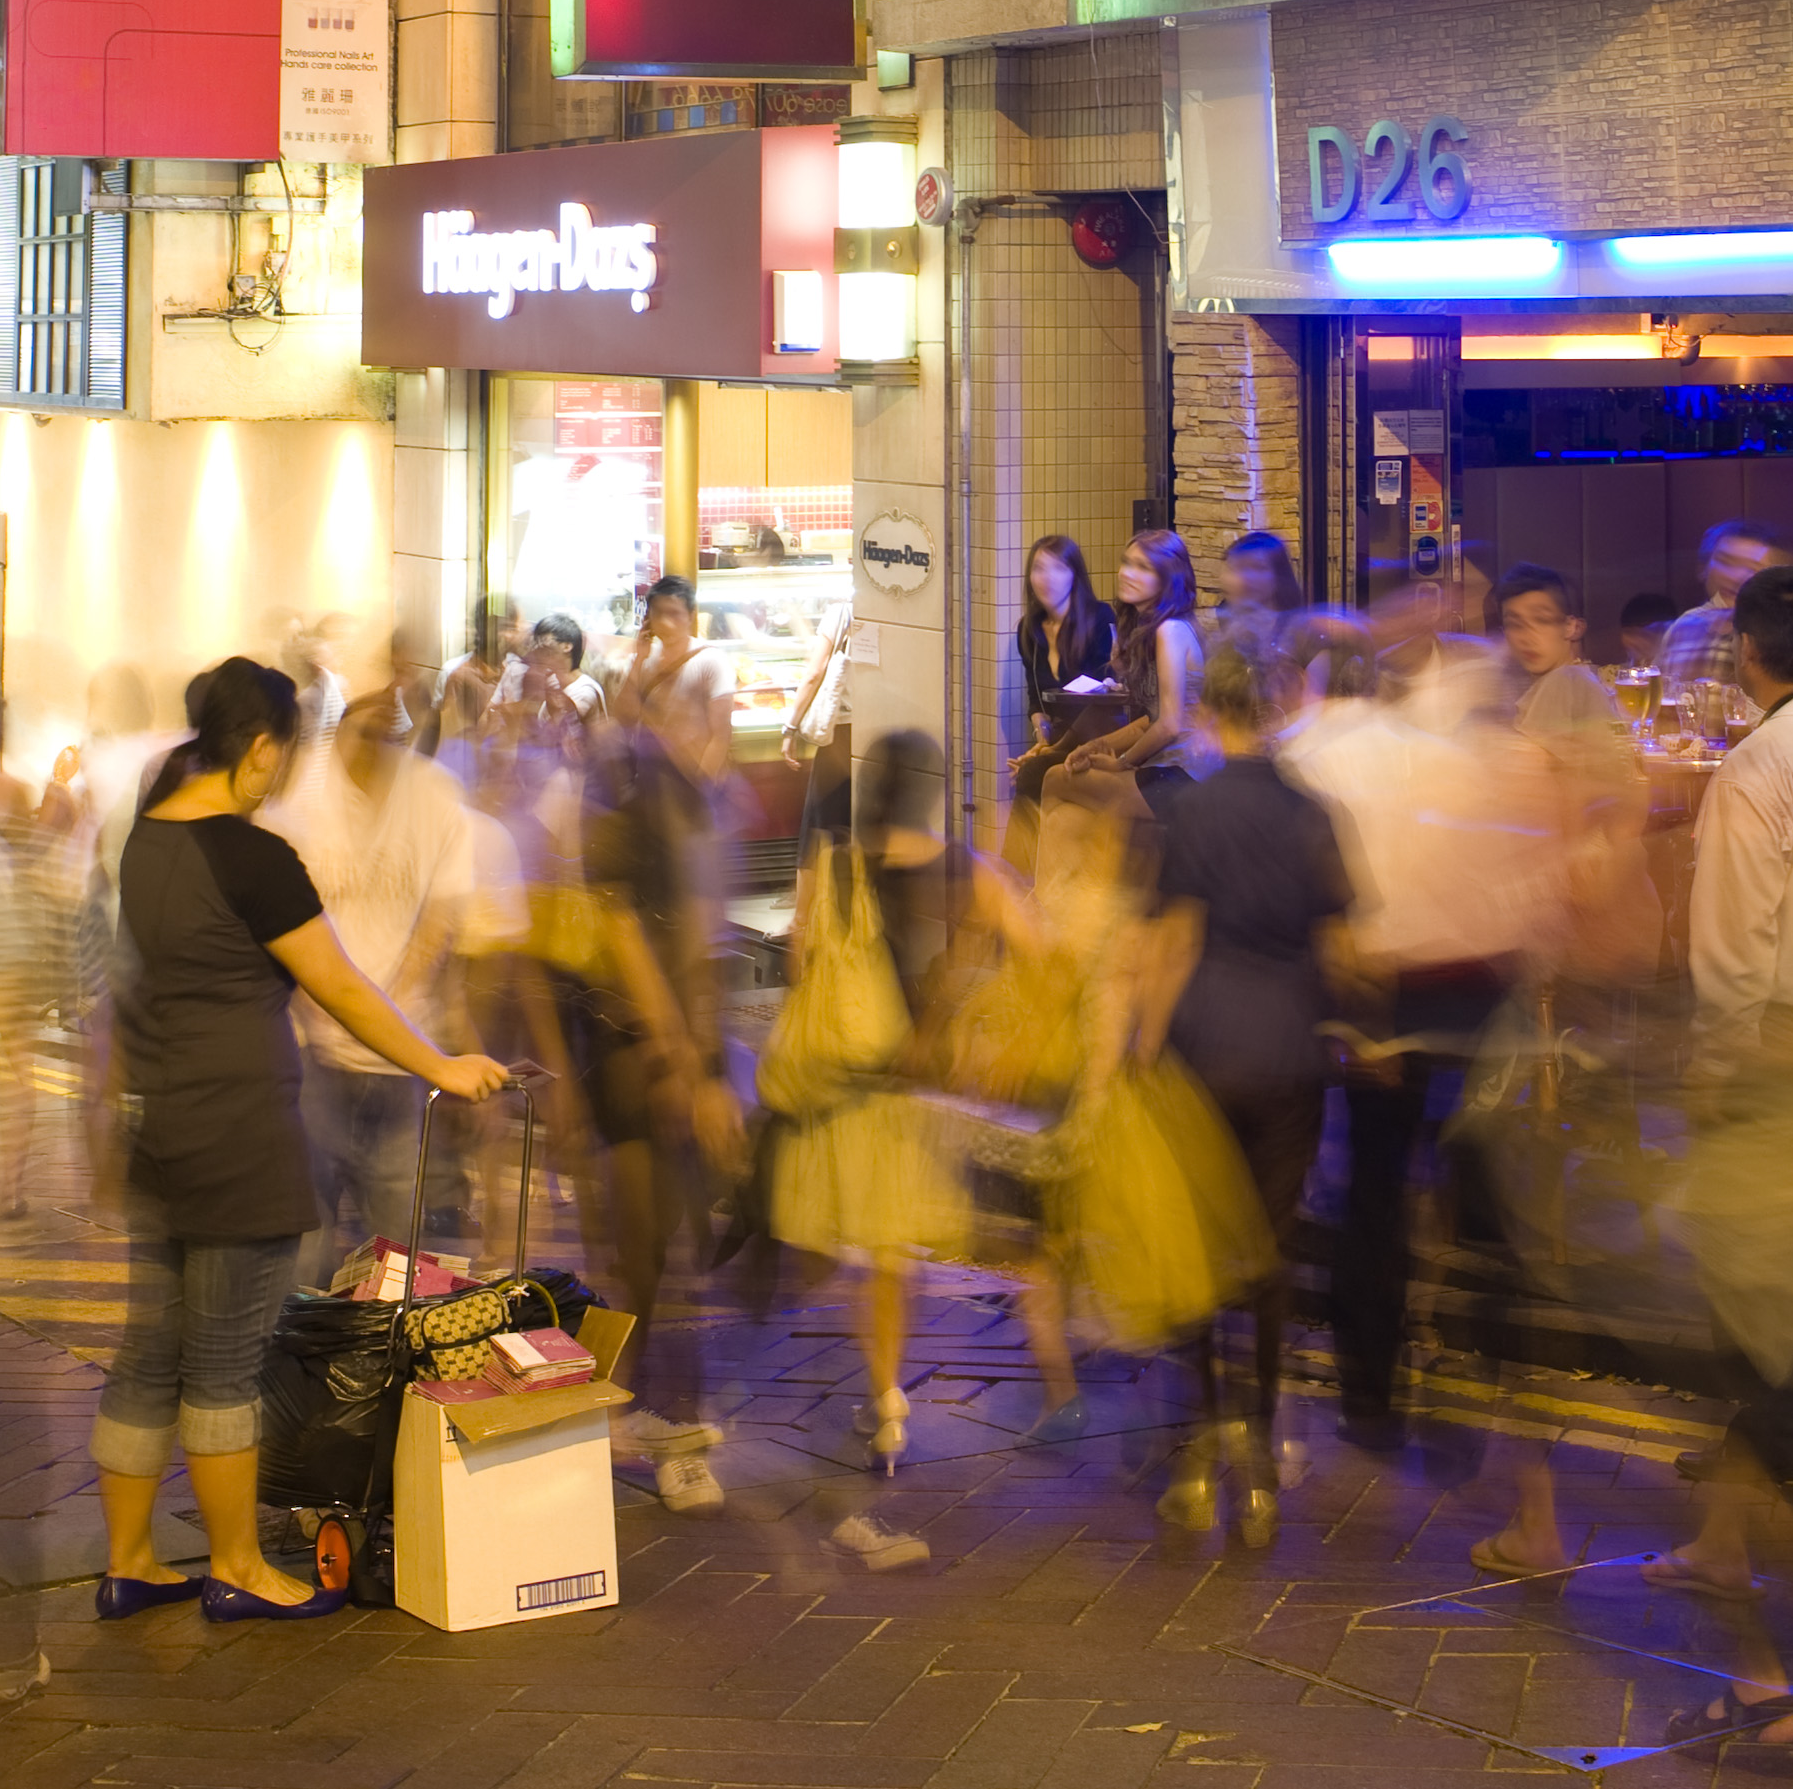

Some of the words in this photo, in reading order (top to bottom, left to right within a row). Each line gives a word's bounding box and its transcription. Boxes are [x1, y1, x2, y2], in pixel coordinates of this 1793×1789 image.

[281, 59, 309, 69] Hands
[311, 62, 332, 70] care
[335, 62, 378, 72] collection
[285, 48, 337, 59] Professional
[339, 51, 360, 60] Nails
[362, 52, 374, 60] Art
[1306, 116, 1474, 225] D26
[422, 201, 657, 320] Häagen-Dazs
[863, 540, 930, 570] Häagen-Dazs
